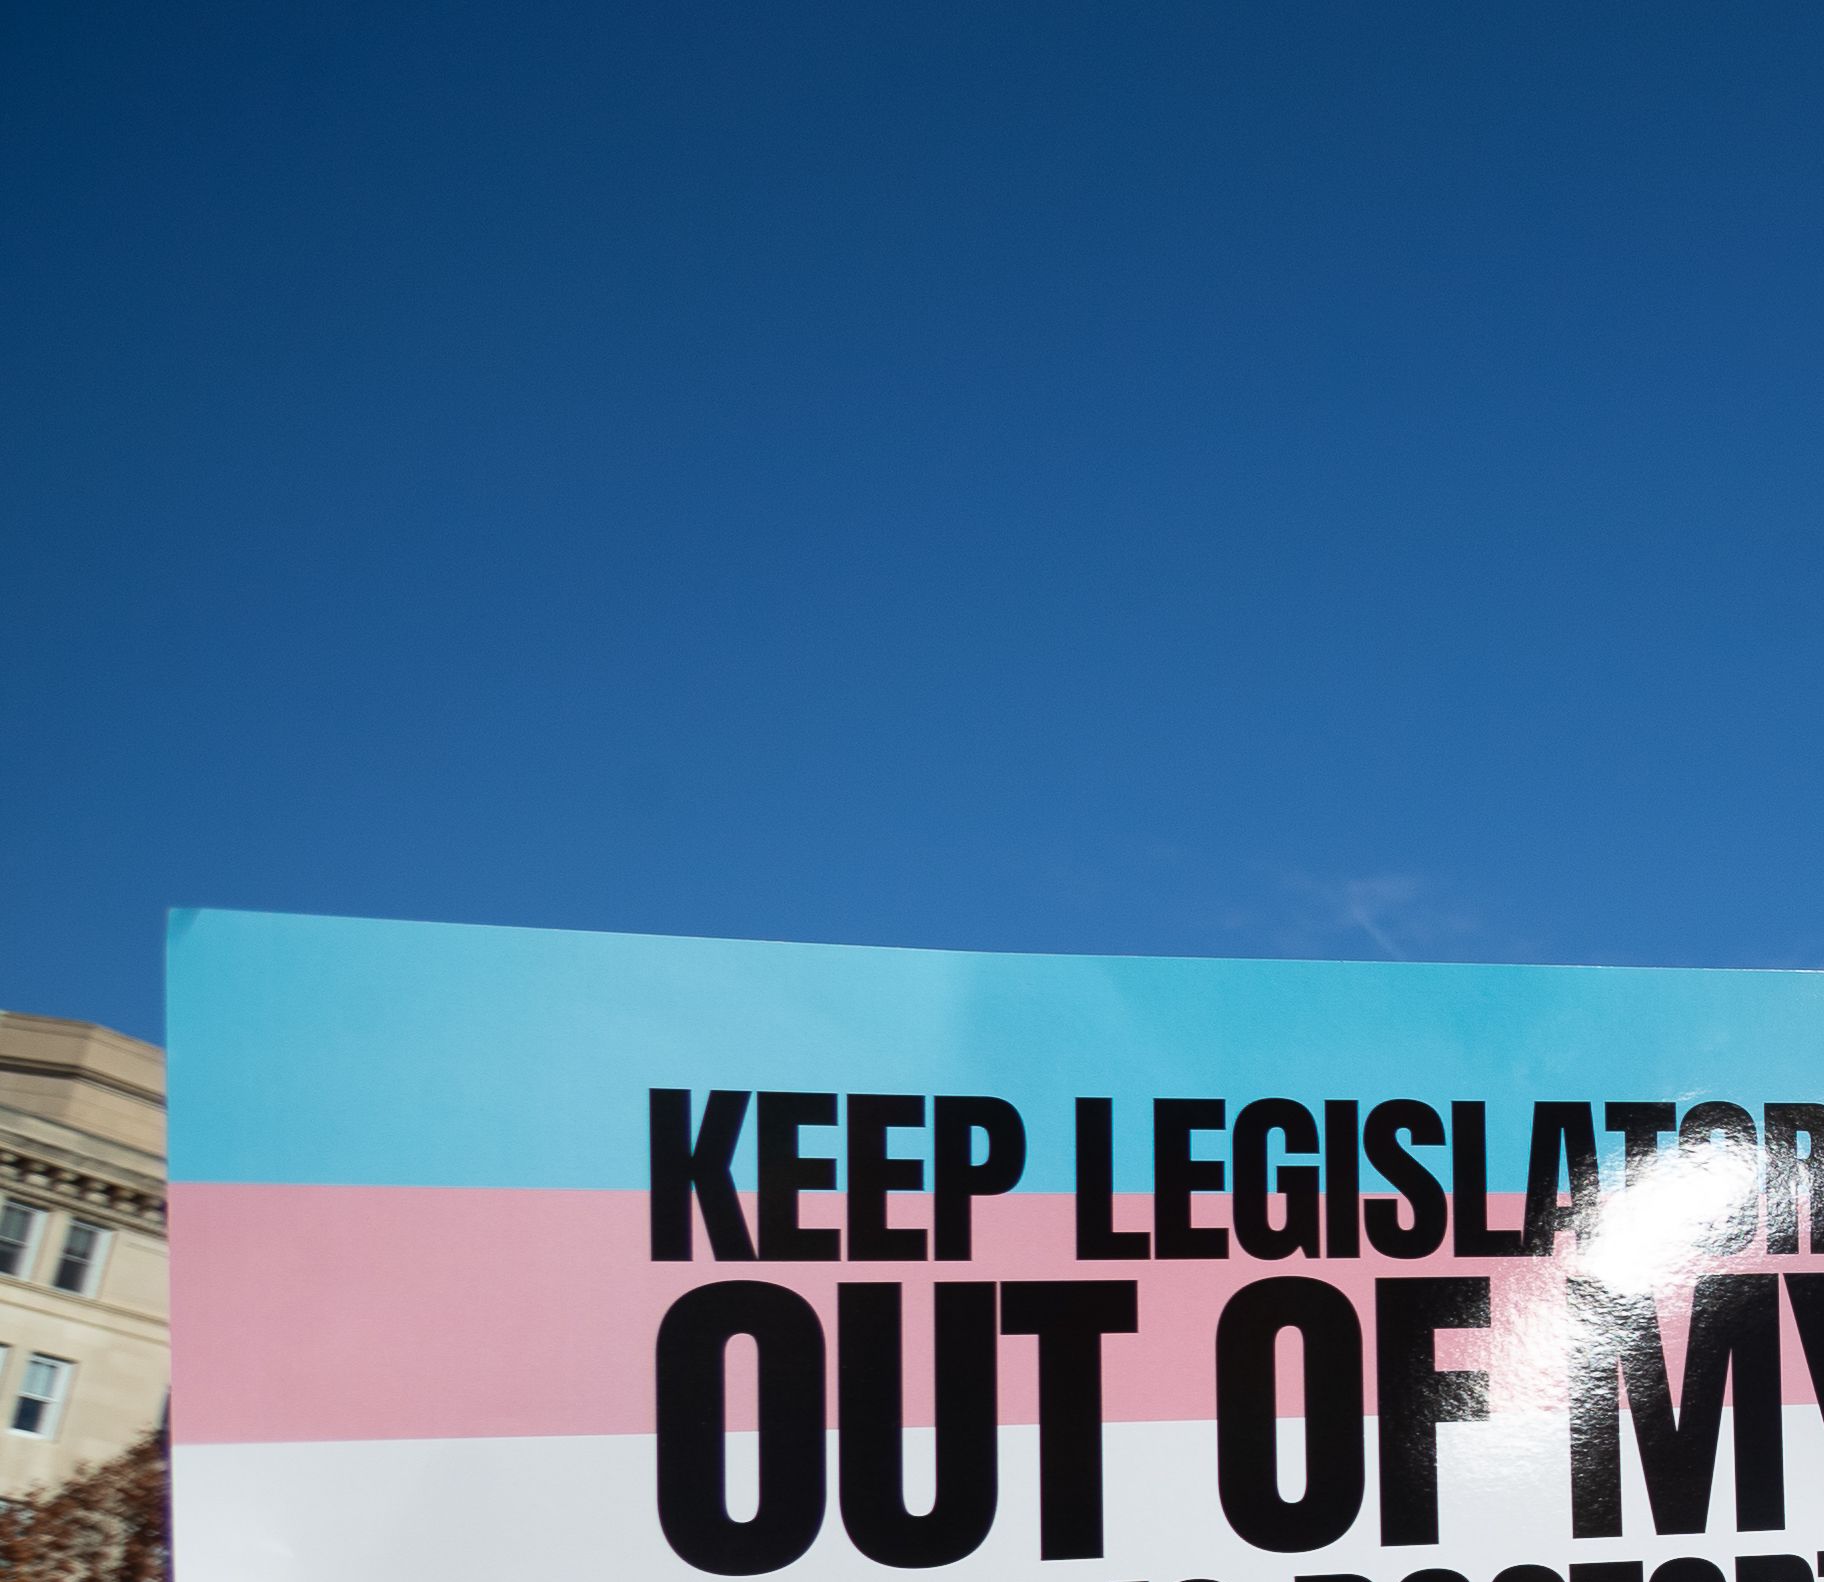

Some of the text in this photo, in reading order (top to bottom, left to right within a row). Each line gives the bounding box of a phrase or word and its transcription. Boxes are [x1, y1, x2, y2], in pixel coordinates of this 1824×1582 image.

[649, 1088, 1027, 1262] KEEP
[655, 1279, 1139, 1577] OUT
[1215, 1275, 1491, 1554] OF
